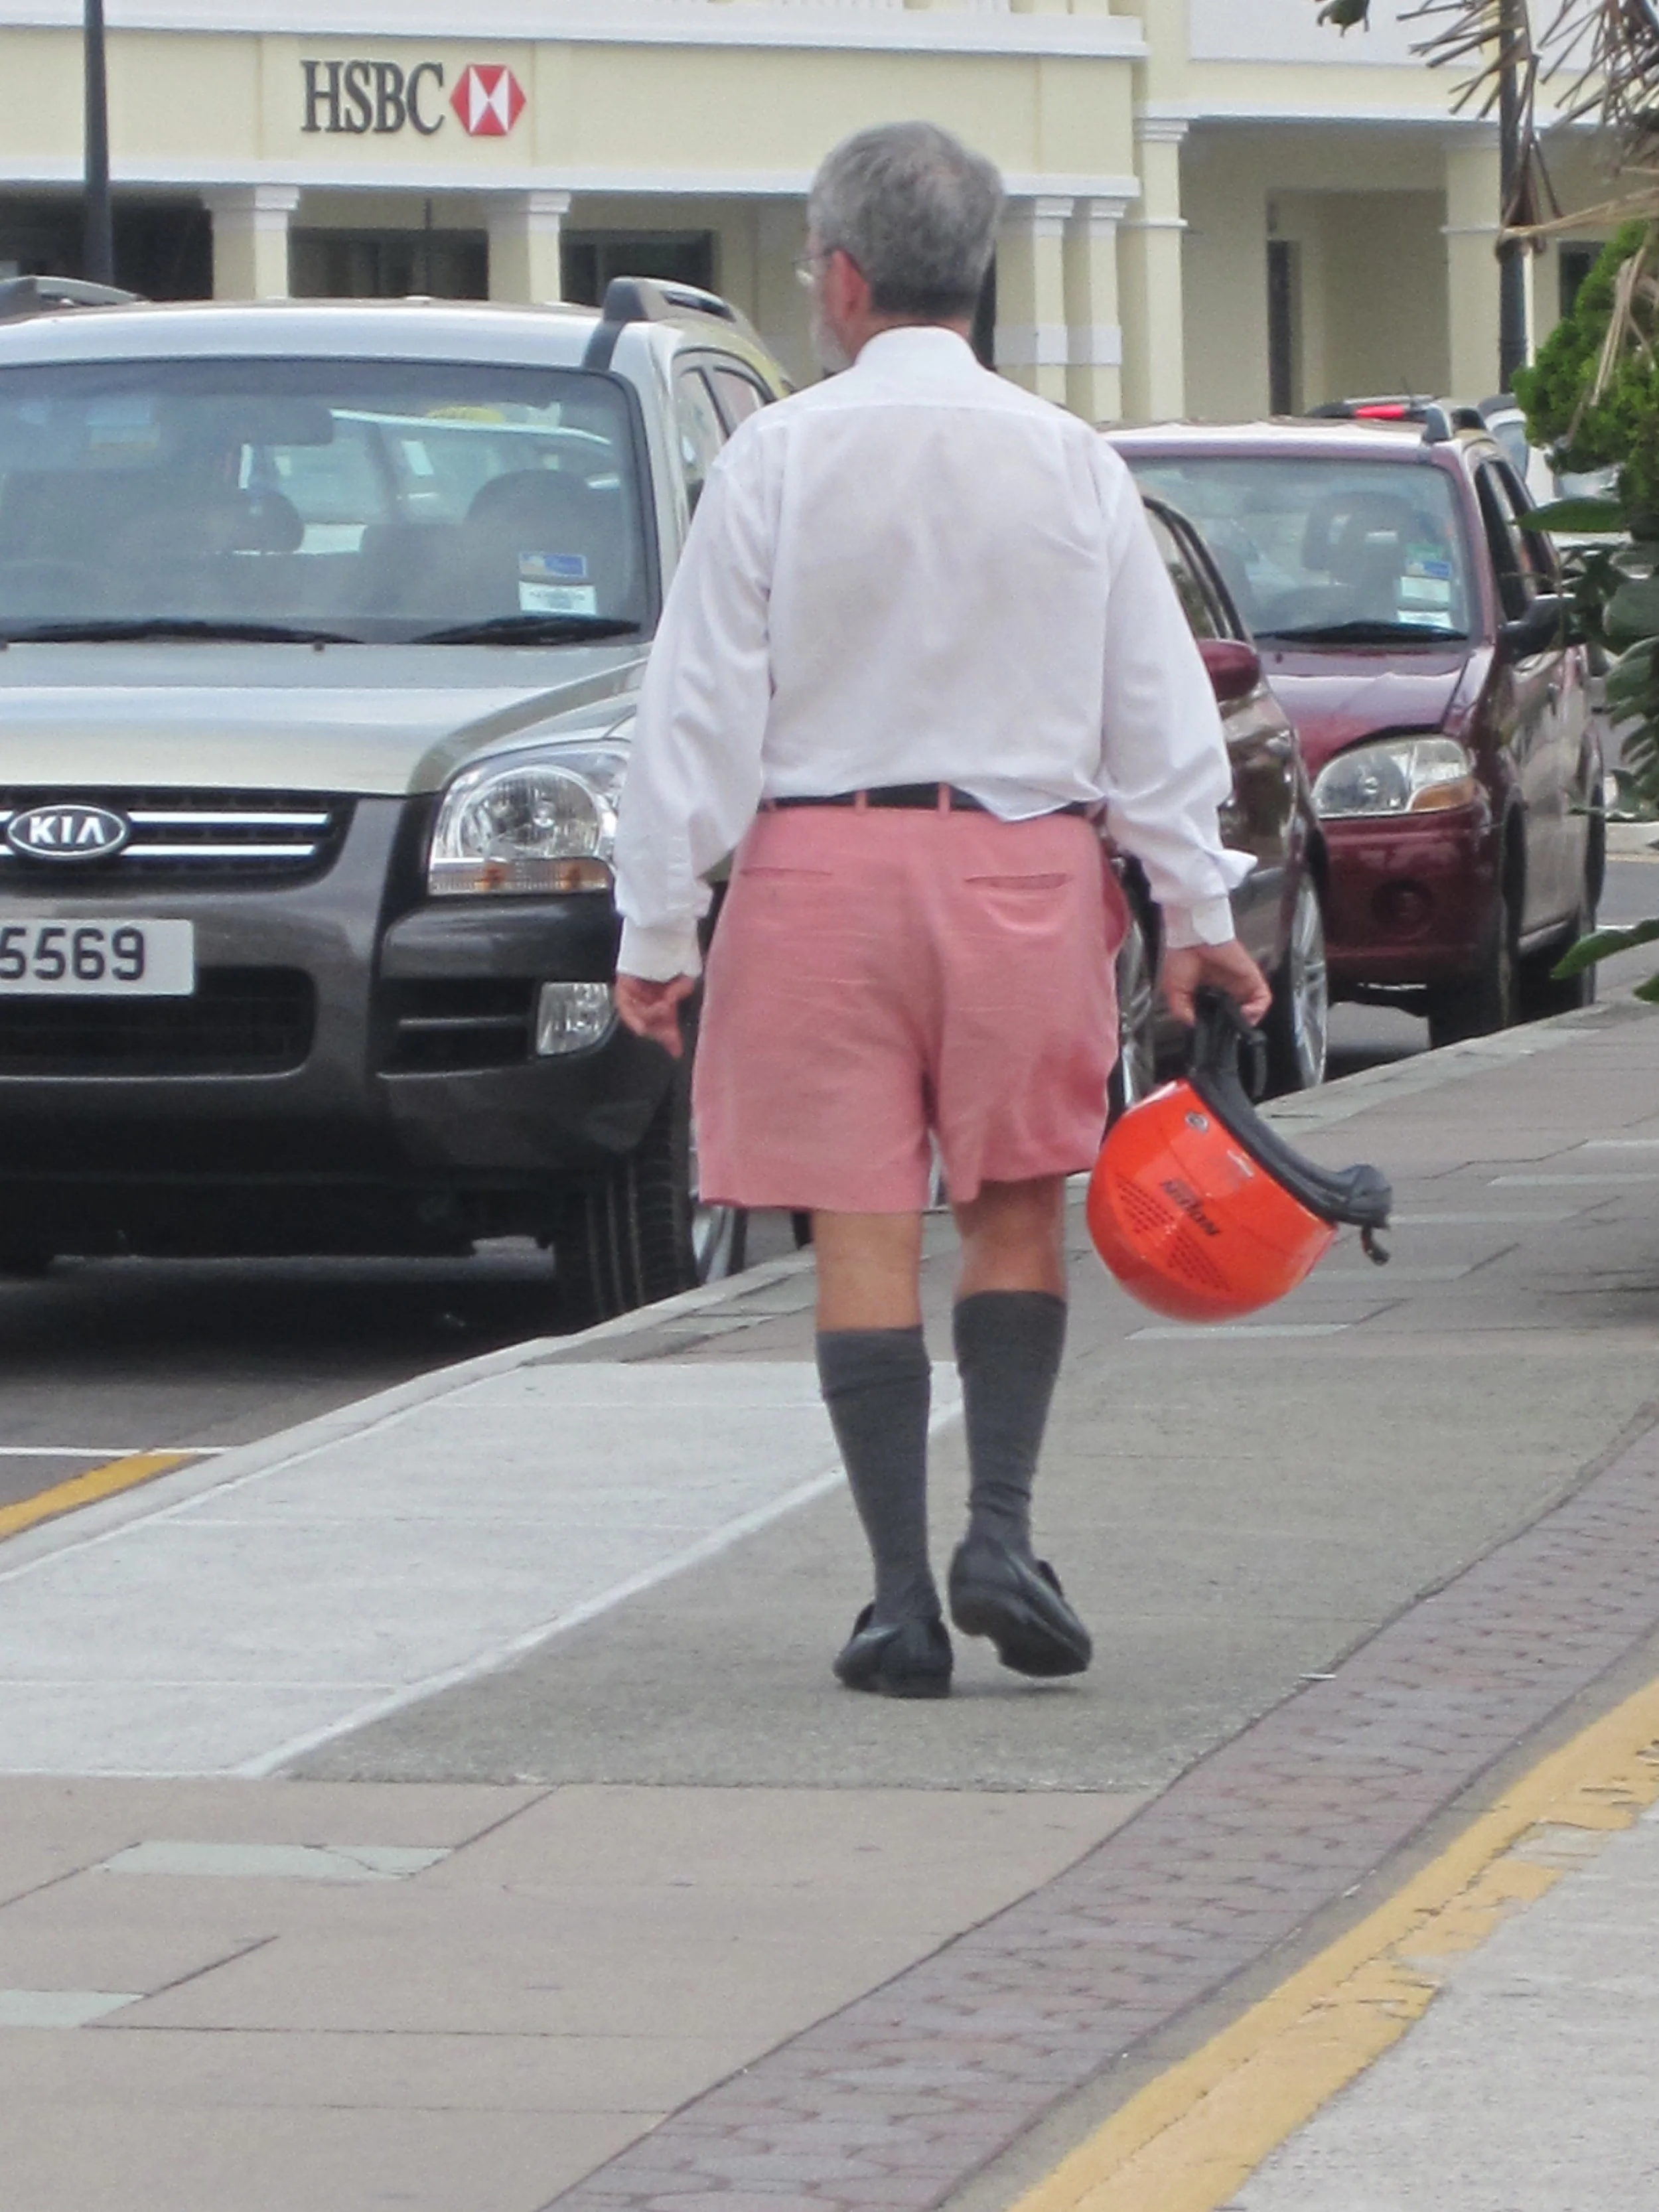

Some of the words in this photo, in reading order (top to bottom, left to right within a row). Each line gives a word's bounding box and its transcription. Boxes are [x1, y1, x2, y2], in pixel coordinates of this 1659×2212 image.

[301, 60, 445, 135] HSBC
[29, 816, 105, 845] KIA
[0, 926, 144, 980] 5569
